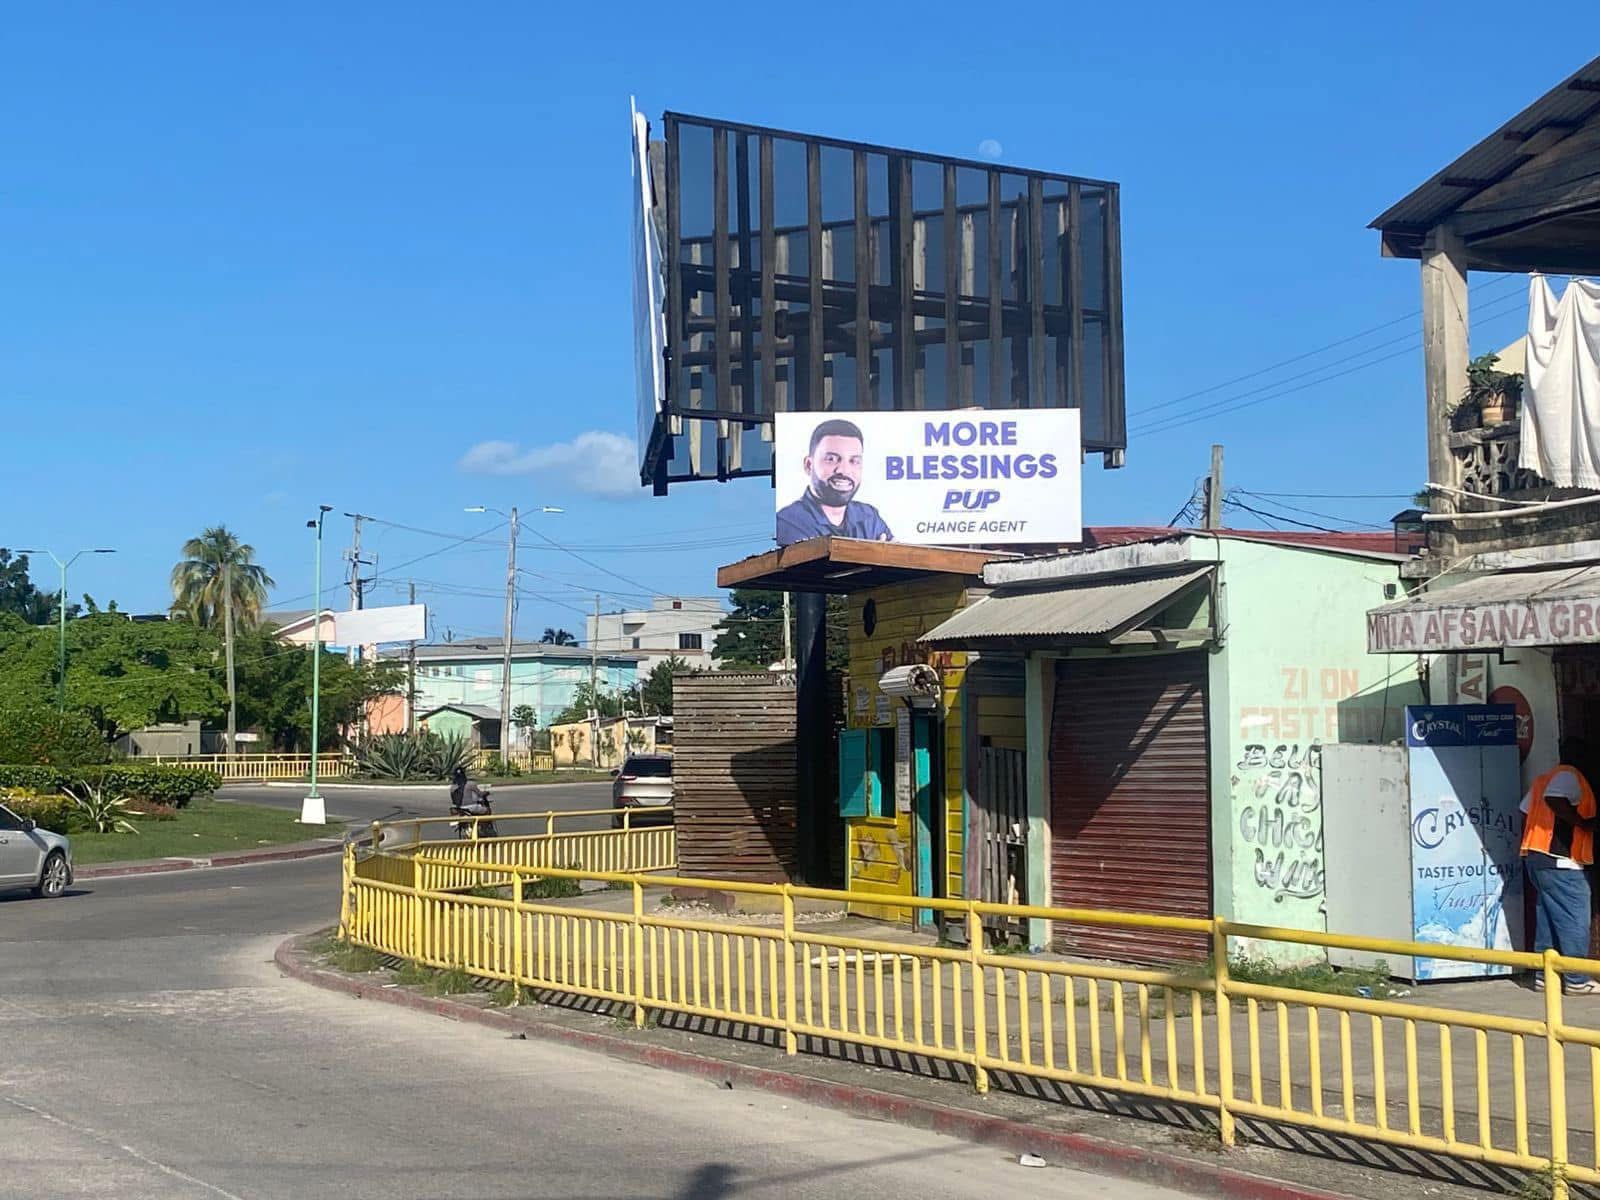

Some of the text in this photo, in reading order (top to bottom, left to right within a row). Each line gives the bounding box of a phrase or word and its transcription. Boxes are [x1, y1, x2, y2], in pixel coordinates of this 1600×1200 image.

[924, 421, 1017, 447] MORE
[885, 454, 1058, 480] BLESSINGS
[943, 490, 1001, 510] PUP
[916, 520, 1028, 534] CHANGE AGENT
[1423, 606, 1542, 646] AFSANA
[1549, 602, 1600, 640] GR
[1240, 706, 1320, 739] FAST
[1411, 719, 1463, 741] CRYSTAL
[1412, 806, 1517, 850] CRYSTAL
[1418, 864, 1514, 879] TASTE YOU CAN
[1433, 881, 1497, 913] Trust
